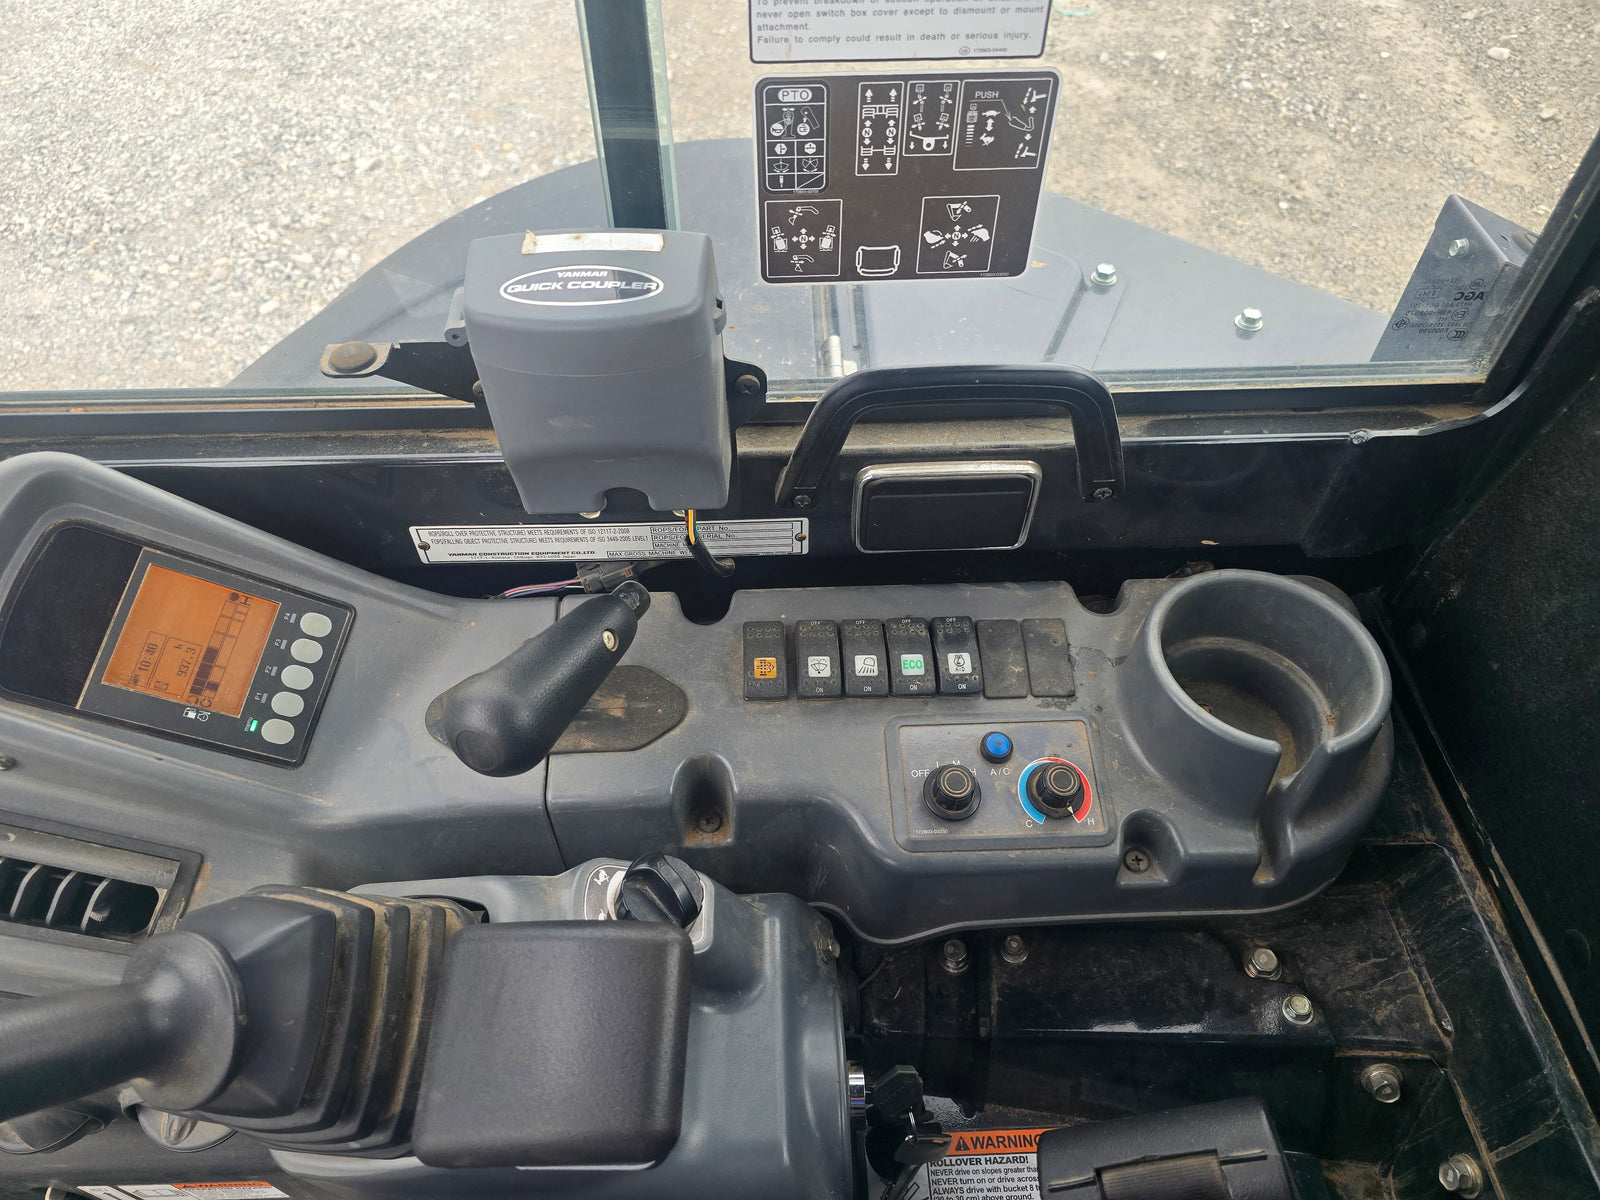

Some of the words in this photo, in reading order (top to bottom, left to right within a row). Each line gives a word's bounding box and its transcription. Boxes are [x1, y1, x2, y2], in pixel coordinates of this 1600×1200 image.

[788, 10, 810, 19] open
[816, 9, 845, 17] switch
[904, 8, 934, 17] except
[757, 23, 811, 32] attachment.
[757, 36, 790, 44] Failure
[808, 35, 840, 44] comply
[876, 34, 902, 42] result
[1004, 32, 1032, 40] injury.
[782, 90, 810, 100] PTO
[506, 282, 564, 294] QUICK
[567, 280, 658, 290] COUPLER
[274, 638, 282, 646] F3
[138, 643, 158, 672] 10:40
[176, 647, 196, 678] 937.3
[264, 666, 272, 674] F2
[902, 660, 923, 670] ECO
[254, 692, 262, 701] F1
[244, 716, 254, 732] menu
[910, 770, 930, 778] OFF
[990, 768, 1010, 776] A/C
[1026, 820, 1033, 828] C
[930, 1158, 982, 1168] ROLLOVER
[984, 1156, 1028, 1165] HAZARD!
[930, 1168, 954, 1176] NEVER
[954, 1168, 970, 1176] drive
[981, 1167, 1002, 1176] slopes
[1003, 1167, 1025, 1176] greater
[932, 1178, 958, 1186] NEVER
[997, 1176, 1016, 1184] drive
[932, 1186, 964, 1196] ALWAYS
[966, 1186, 984, 1194] drive
[986, 1185, 1002, 1194] with
[1002, 1184, 1028, 1192] bucket
